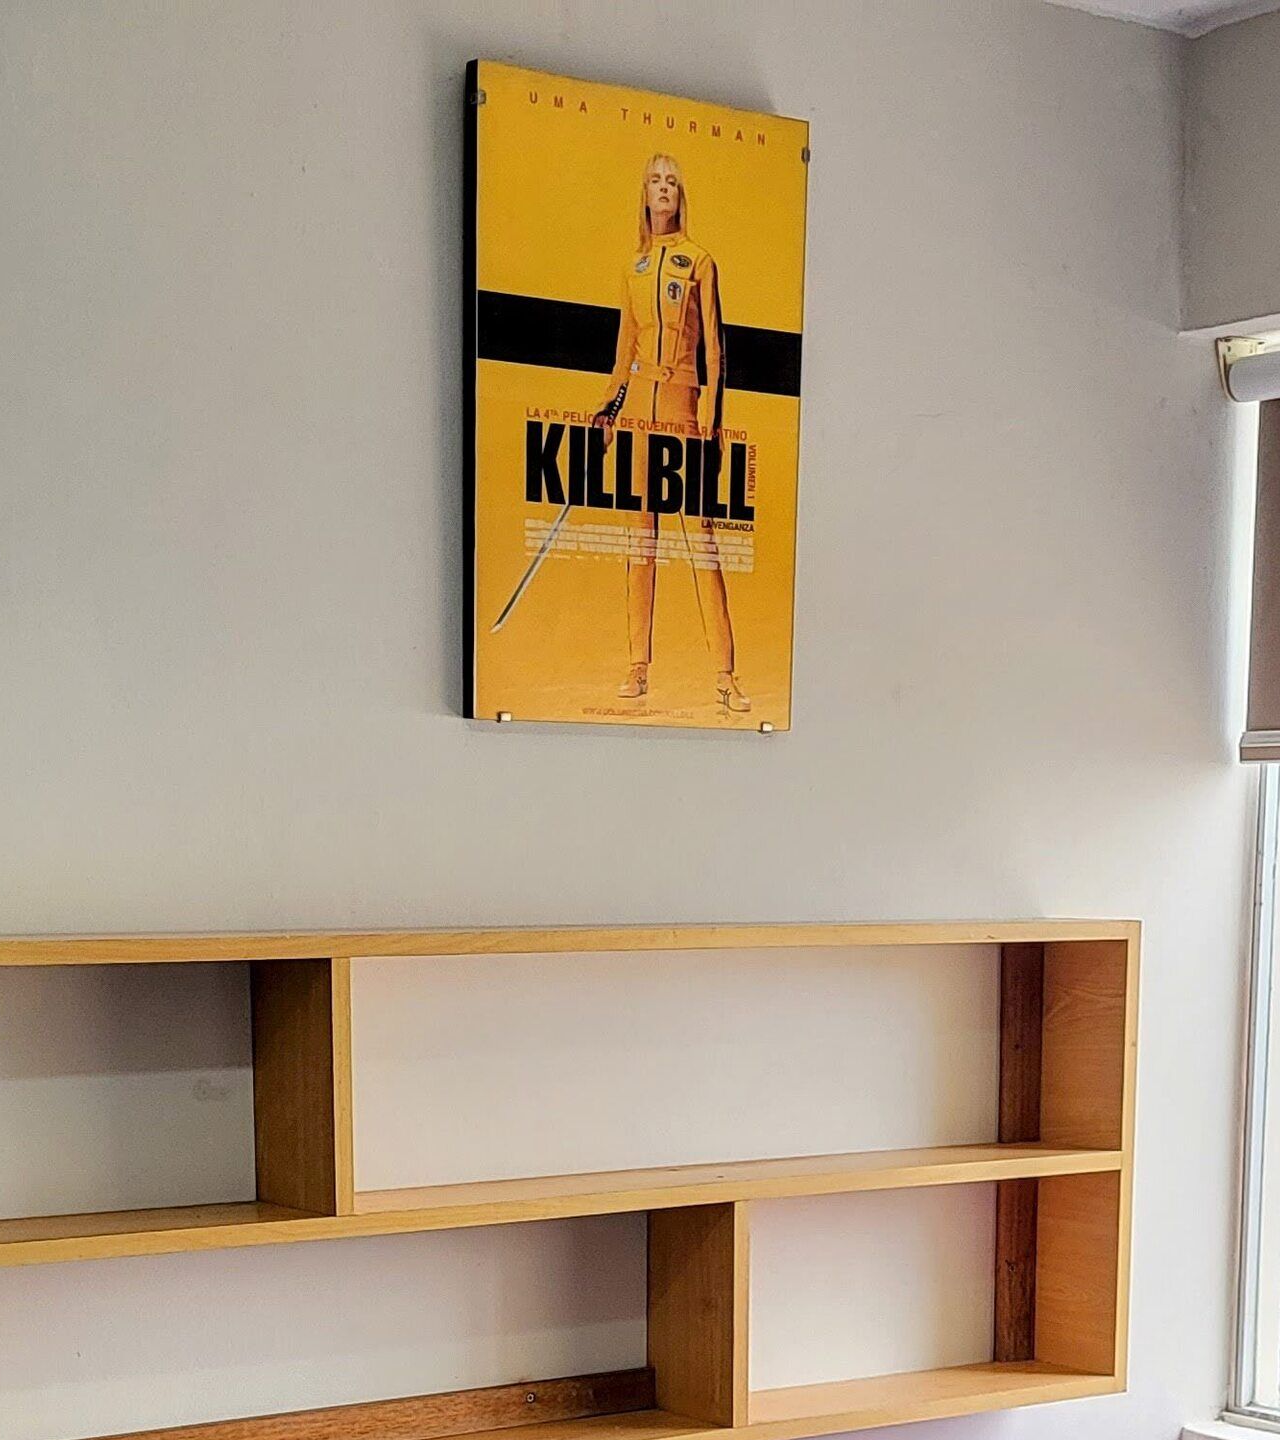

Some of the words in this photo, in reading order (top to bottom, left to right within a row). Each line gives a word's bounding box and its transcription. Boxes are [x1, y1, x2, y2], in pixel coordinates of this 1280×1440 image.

[529, 91, 588, 113] UMA
[621, 108, 765, 145] THURMAN
[526, 407, 540, 418] LA
[620, 417, 634, 428] DE
[637, 419, 685, 434] QUENTIN
[526, 420, 642, 511] KILL
[647, 433, 754, 521] BILL
[747, 445, 757, 492] VOLUMEN
